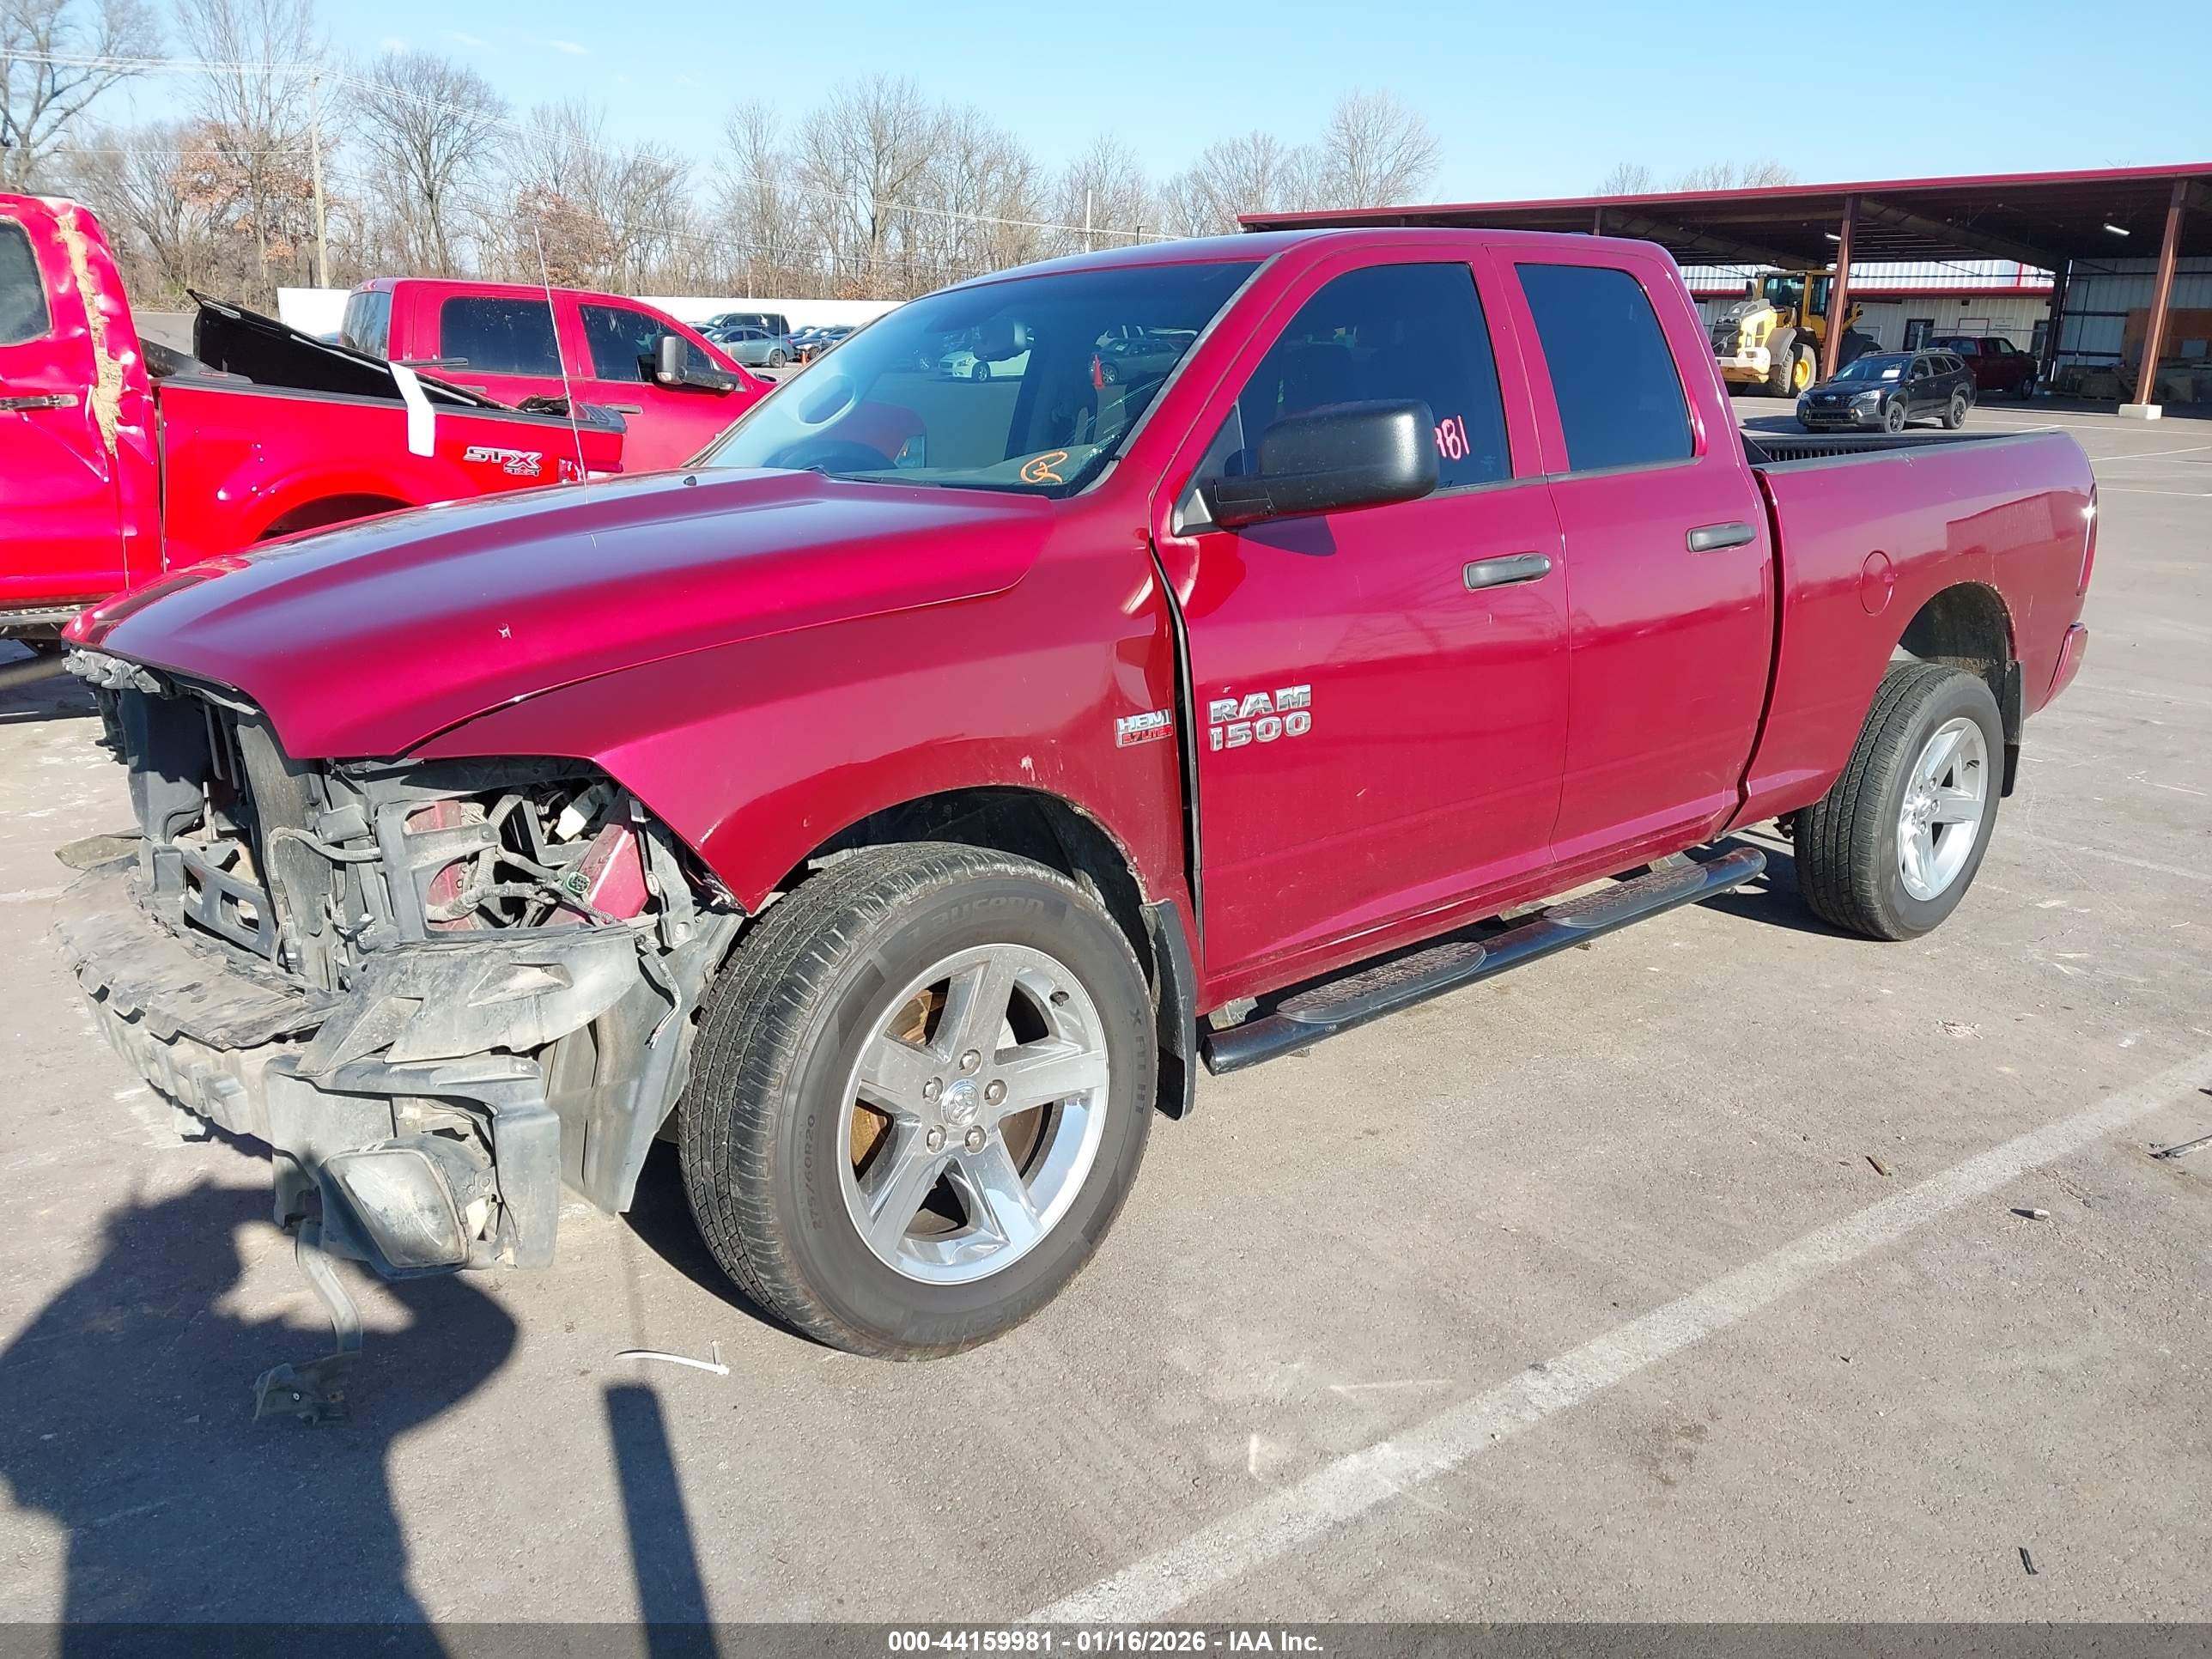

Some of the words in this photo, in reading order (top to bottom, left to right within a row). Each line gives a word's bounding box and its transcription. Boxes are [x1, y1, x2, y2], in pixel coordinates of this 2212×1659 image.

[464, 447, 543, 470] STX
[1209, 684, 1311, 724] RAM
[1117, 709, 1172, 732] HEMI
[1209, 711, 1311, 751] 1500
